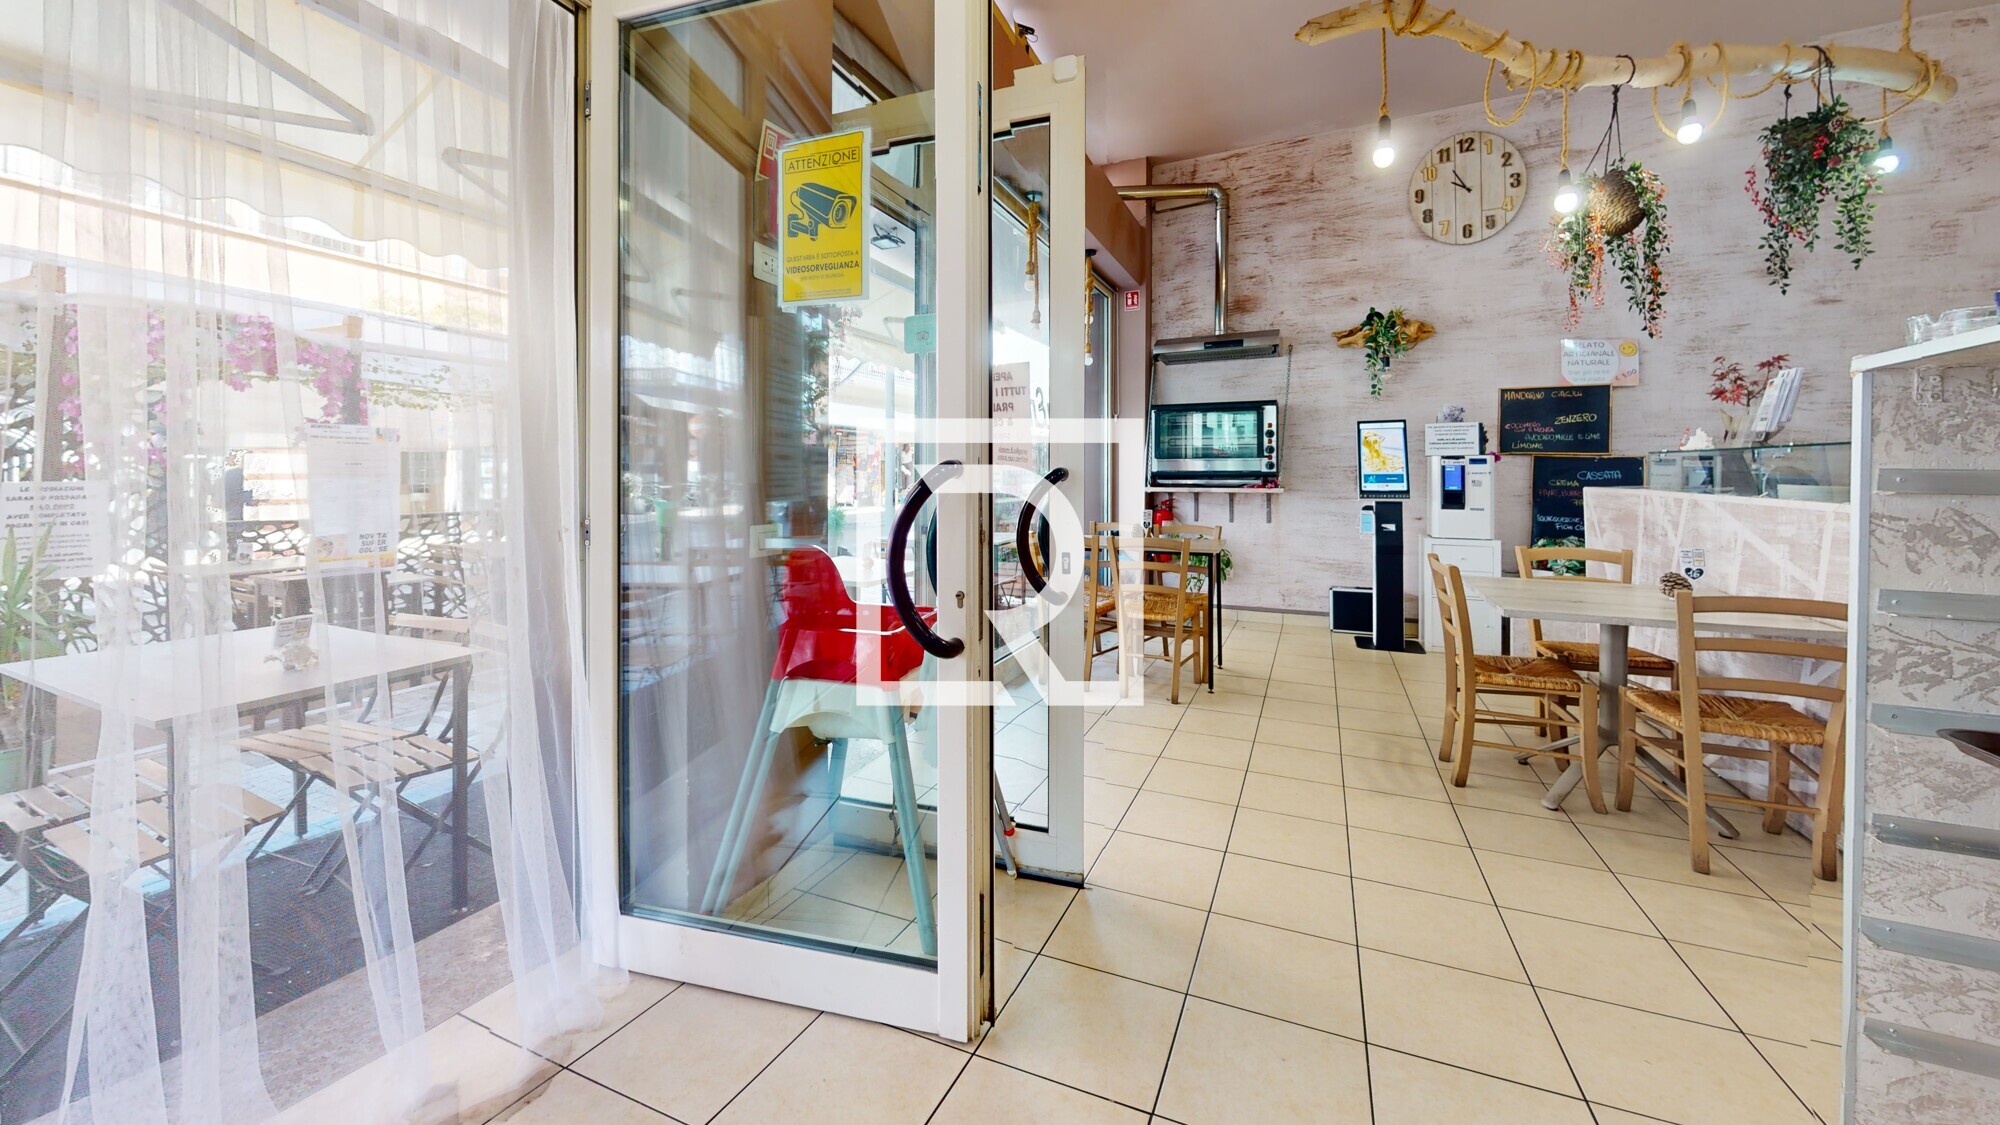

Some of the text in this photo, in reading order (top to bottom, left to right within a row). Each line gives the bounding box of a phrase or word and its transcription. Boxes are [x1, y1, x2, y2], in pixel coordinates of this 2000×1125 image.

[1456, 137, 1475, 153] 12
[1484, 139, 1493, 155] 1
[788, 149, 857, 171] ATTENZIONE
[1436, 147, 1451, 164] 11
[1501, 151, 1512, 167] 2
[1421, 166, 1437, 182] 10
[1509, 172, 1521, 188] 3
[1414, 189, 1425, 204] 9
[1502, 196, 1513, 211] 4
[1422, 208, 1433, 223] 8
[1485, 214, 1496, 230] 5
[1439, 219, 1450, 236] 7
[1462, 224, 1473, 239] 6
[786, 260, 860, 274] VIDEOSORVEGLIANZA
[1554, 413, 1597, 425] ZENZERO
[1511, 441, 1544, 449] LIMONE
[1577, 470, 1622, 480] CASSATA
[1687, 570, 1700, 578] 16
